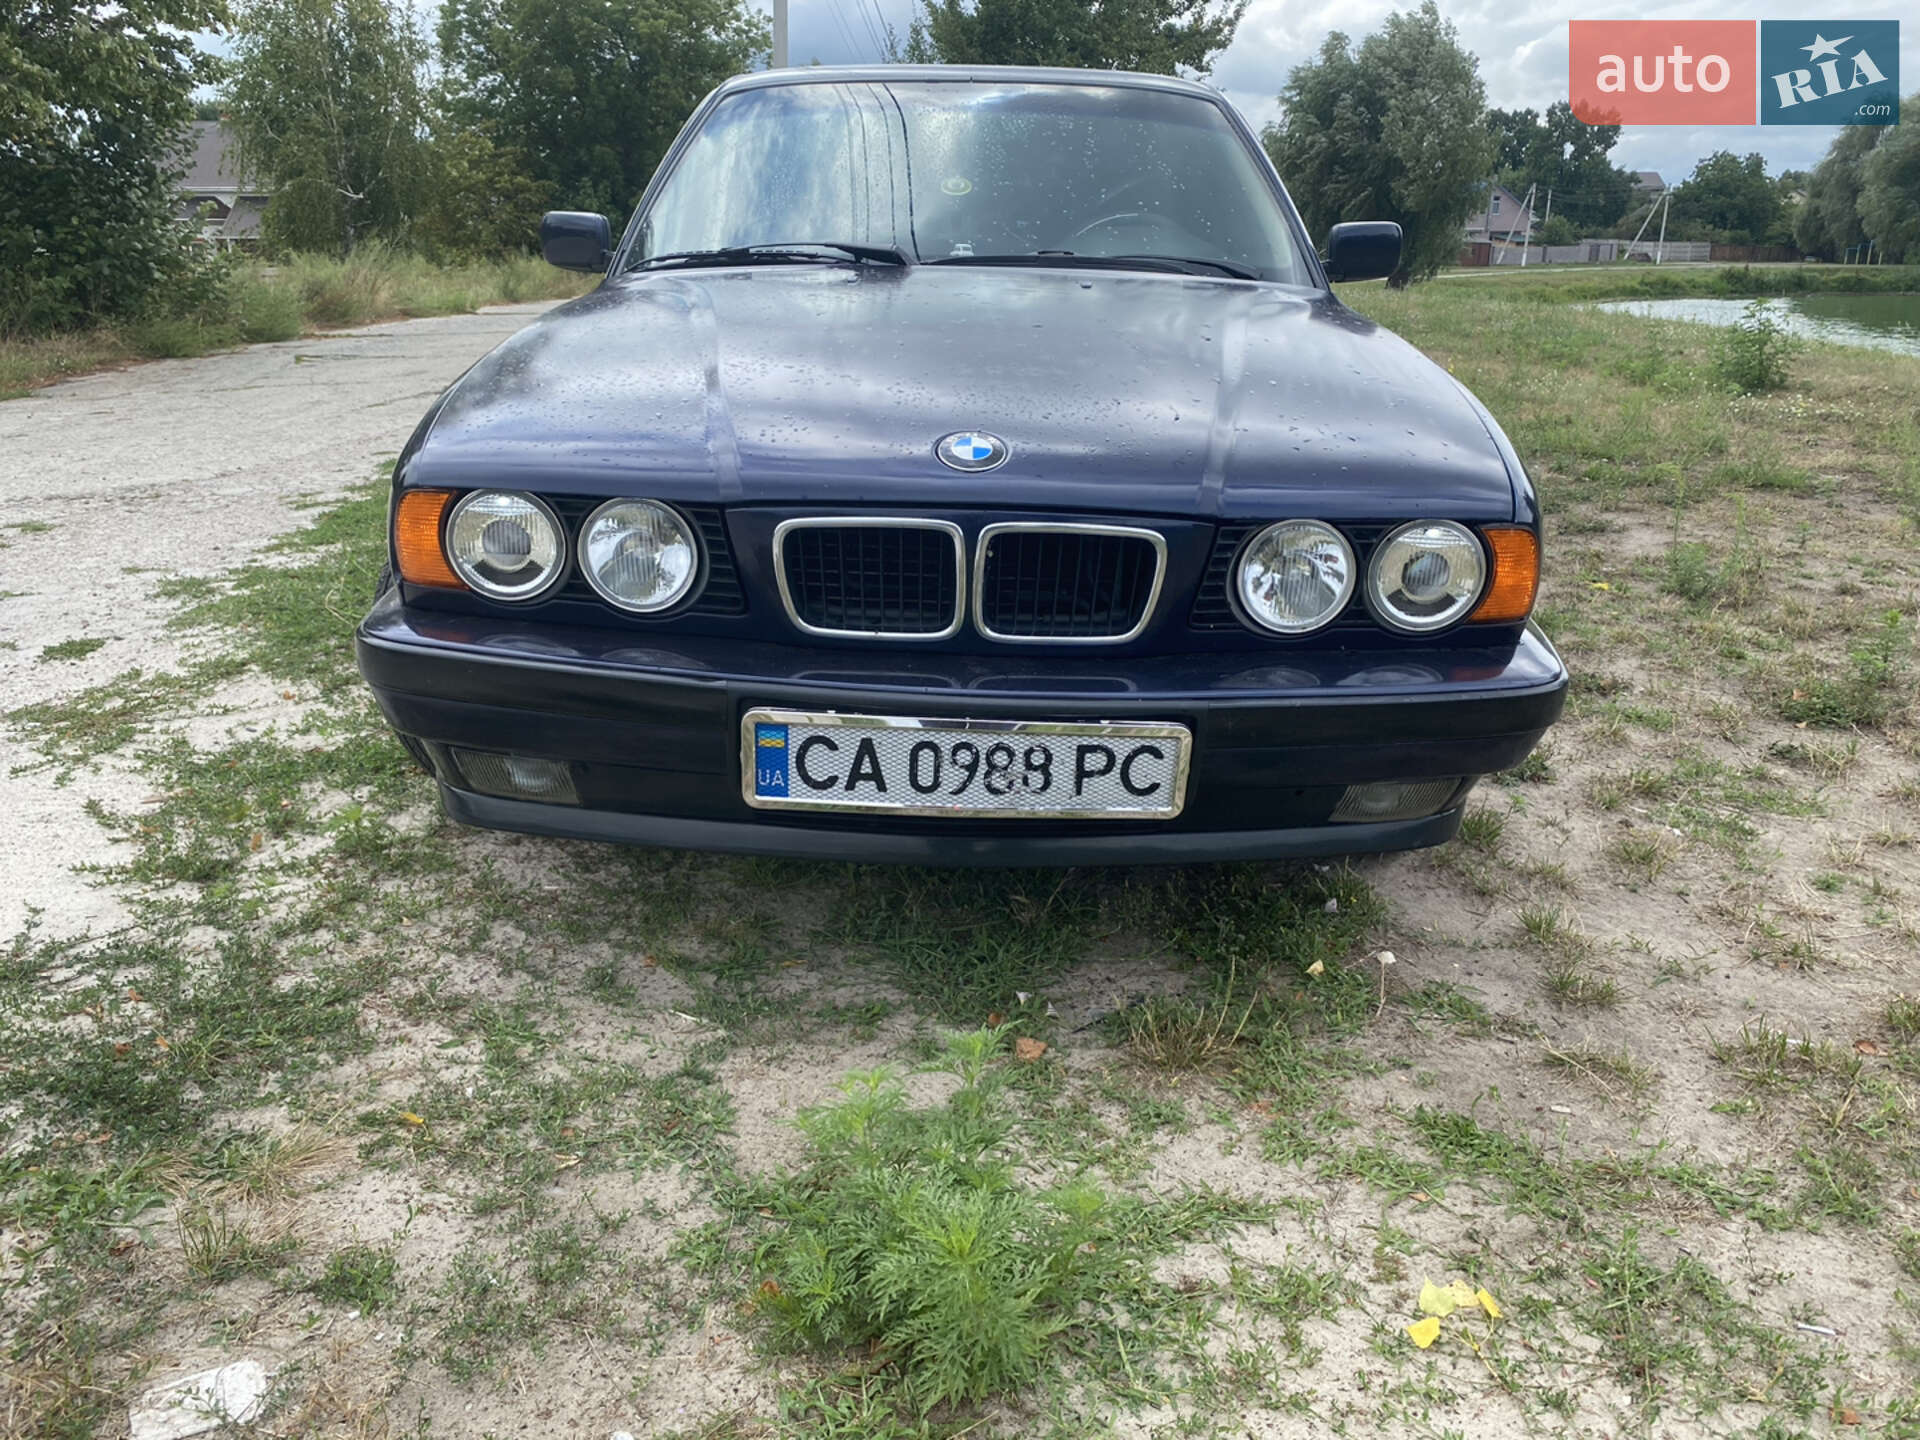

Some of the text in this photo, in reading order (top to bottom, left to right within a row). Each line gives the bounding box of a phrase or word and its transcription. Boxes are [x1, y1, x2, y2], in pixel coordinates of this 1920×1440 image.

[757, 768, 785, 787] UA
[795, 735, 888, 793] CA
[1073, 744, 1164, 797] PC
